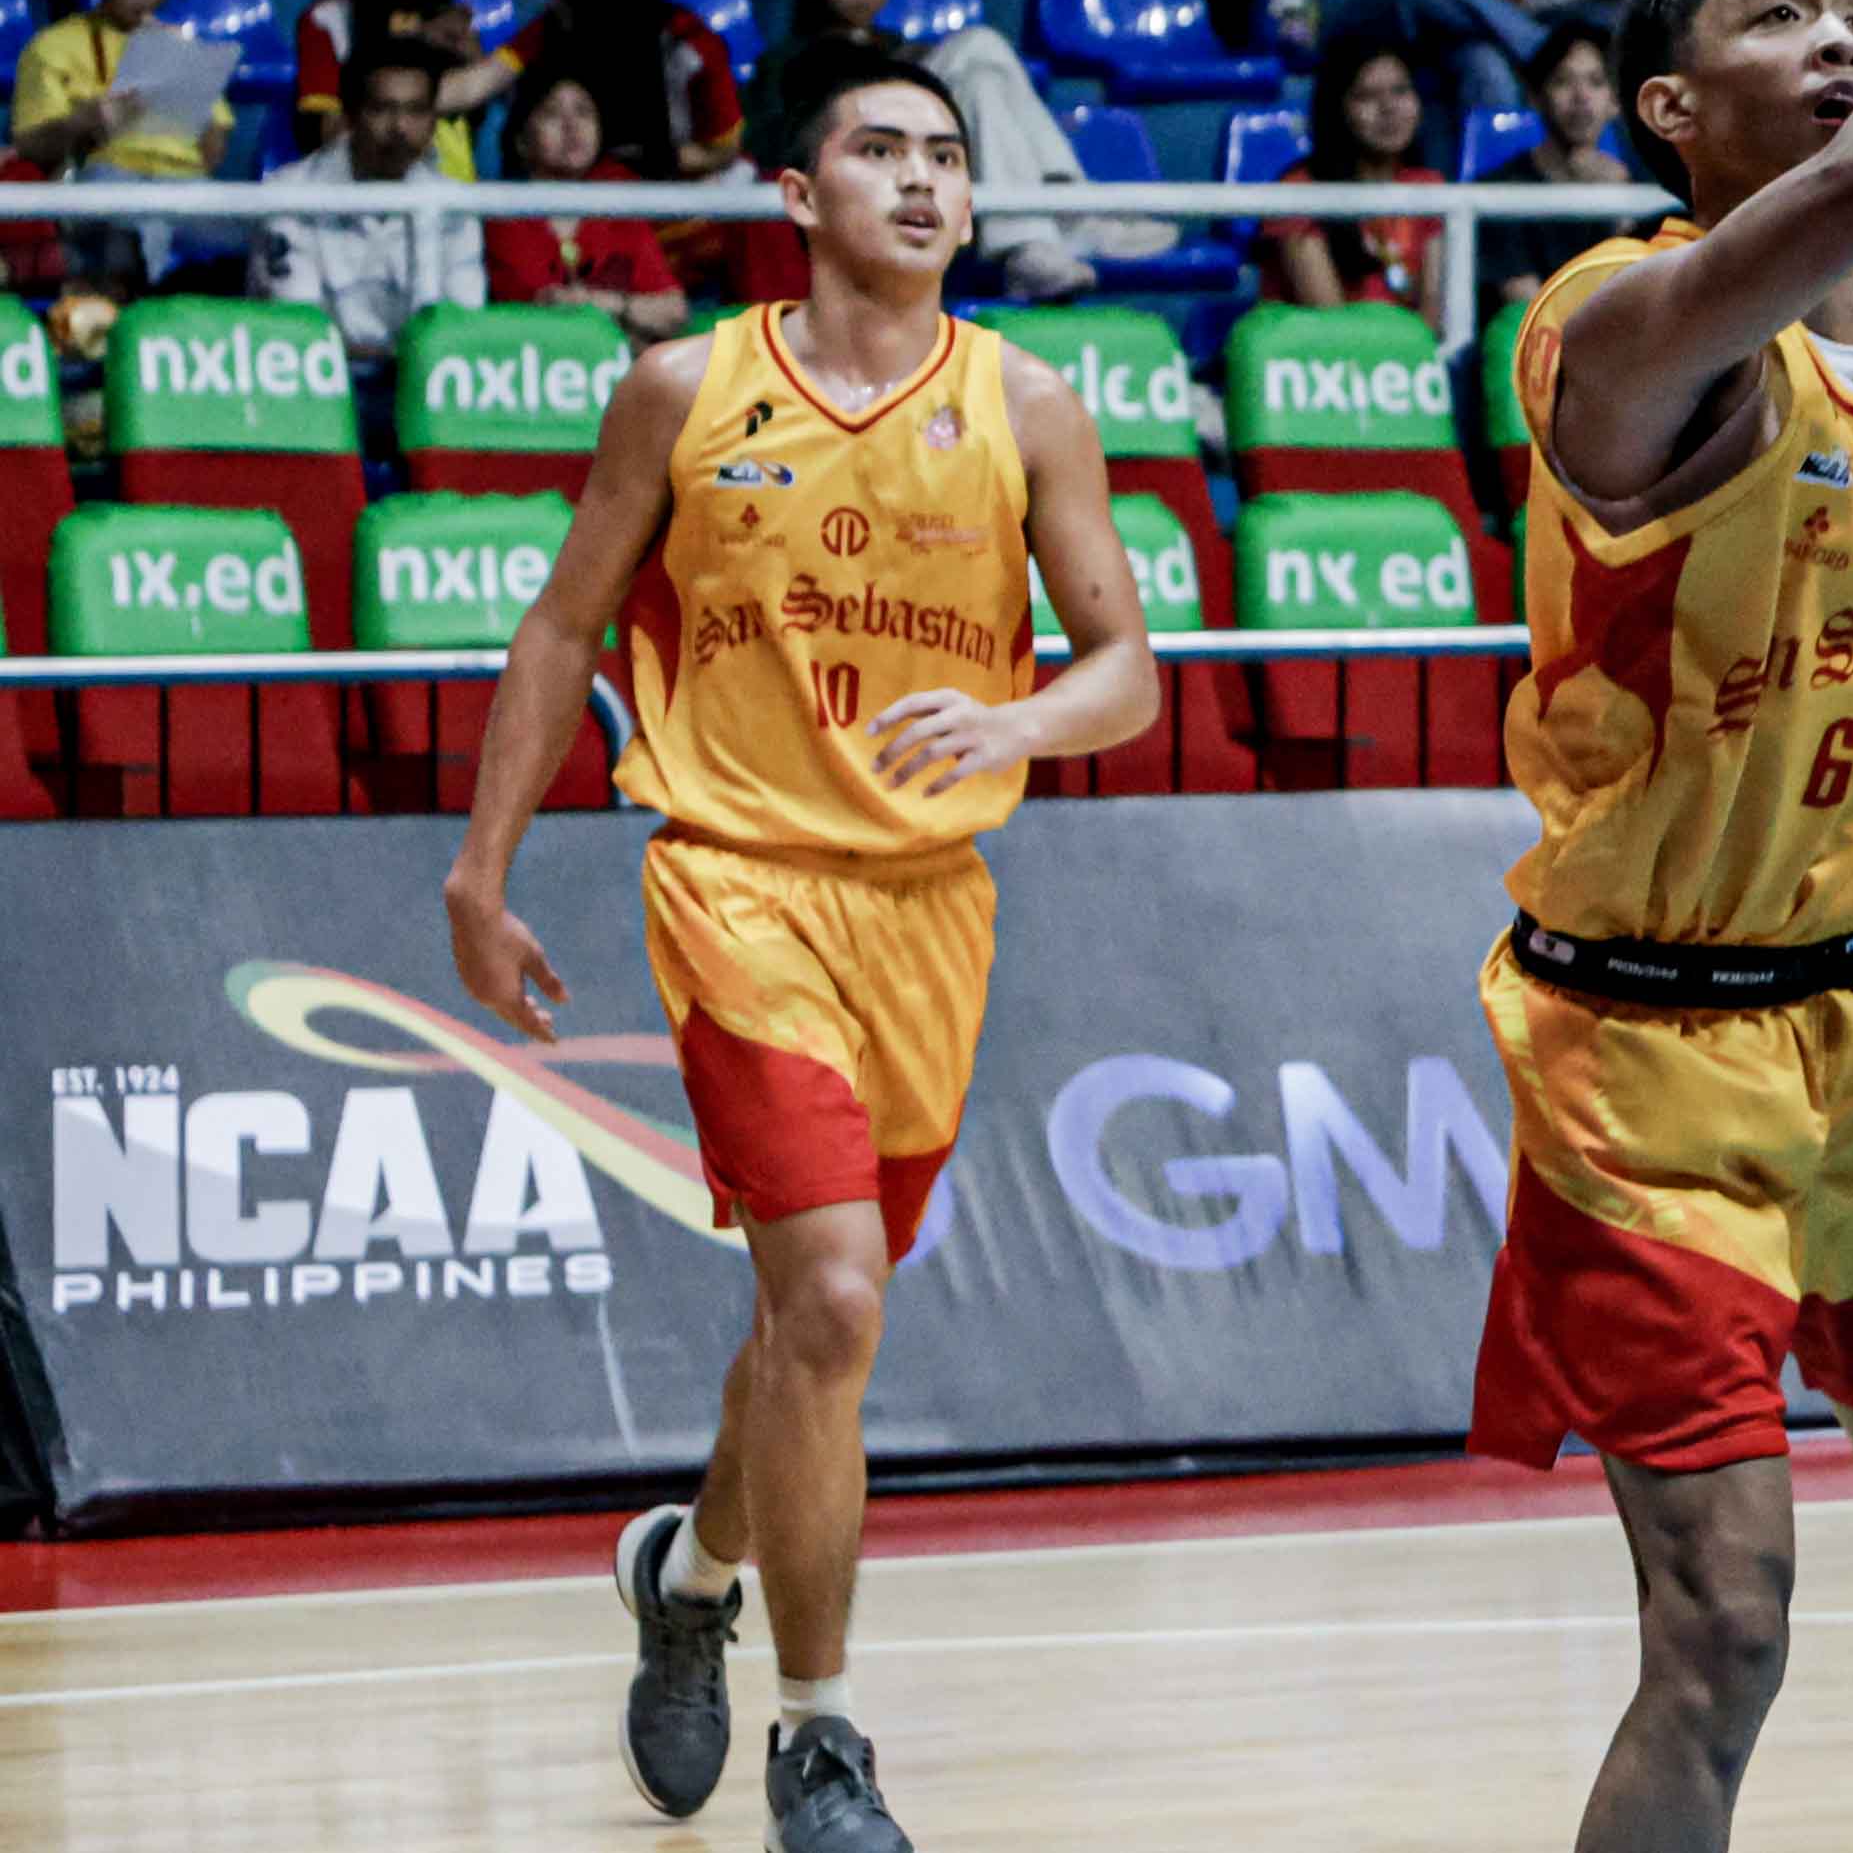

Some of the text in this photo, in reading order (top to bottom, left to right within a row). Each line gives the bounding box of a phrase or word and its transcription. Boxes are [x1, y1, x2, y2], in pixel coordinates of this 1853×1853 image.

[139, 324, 348, 396] nxled
[1266, 535, 1475, 608] nxed
[810, 658, 861, 731] 10
[52, 1065, 181, 1095] EST. 1924
[52, 1086, 606, 1270] NCAA
[52, 1252, 615, 1314] PHILIPPINES
